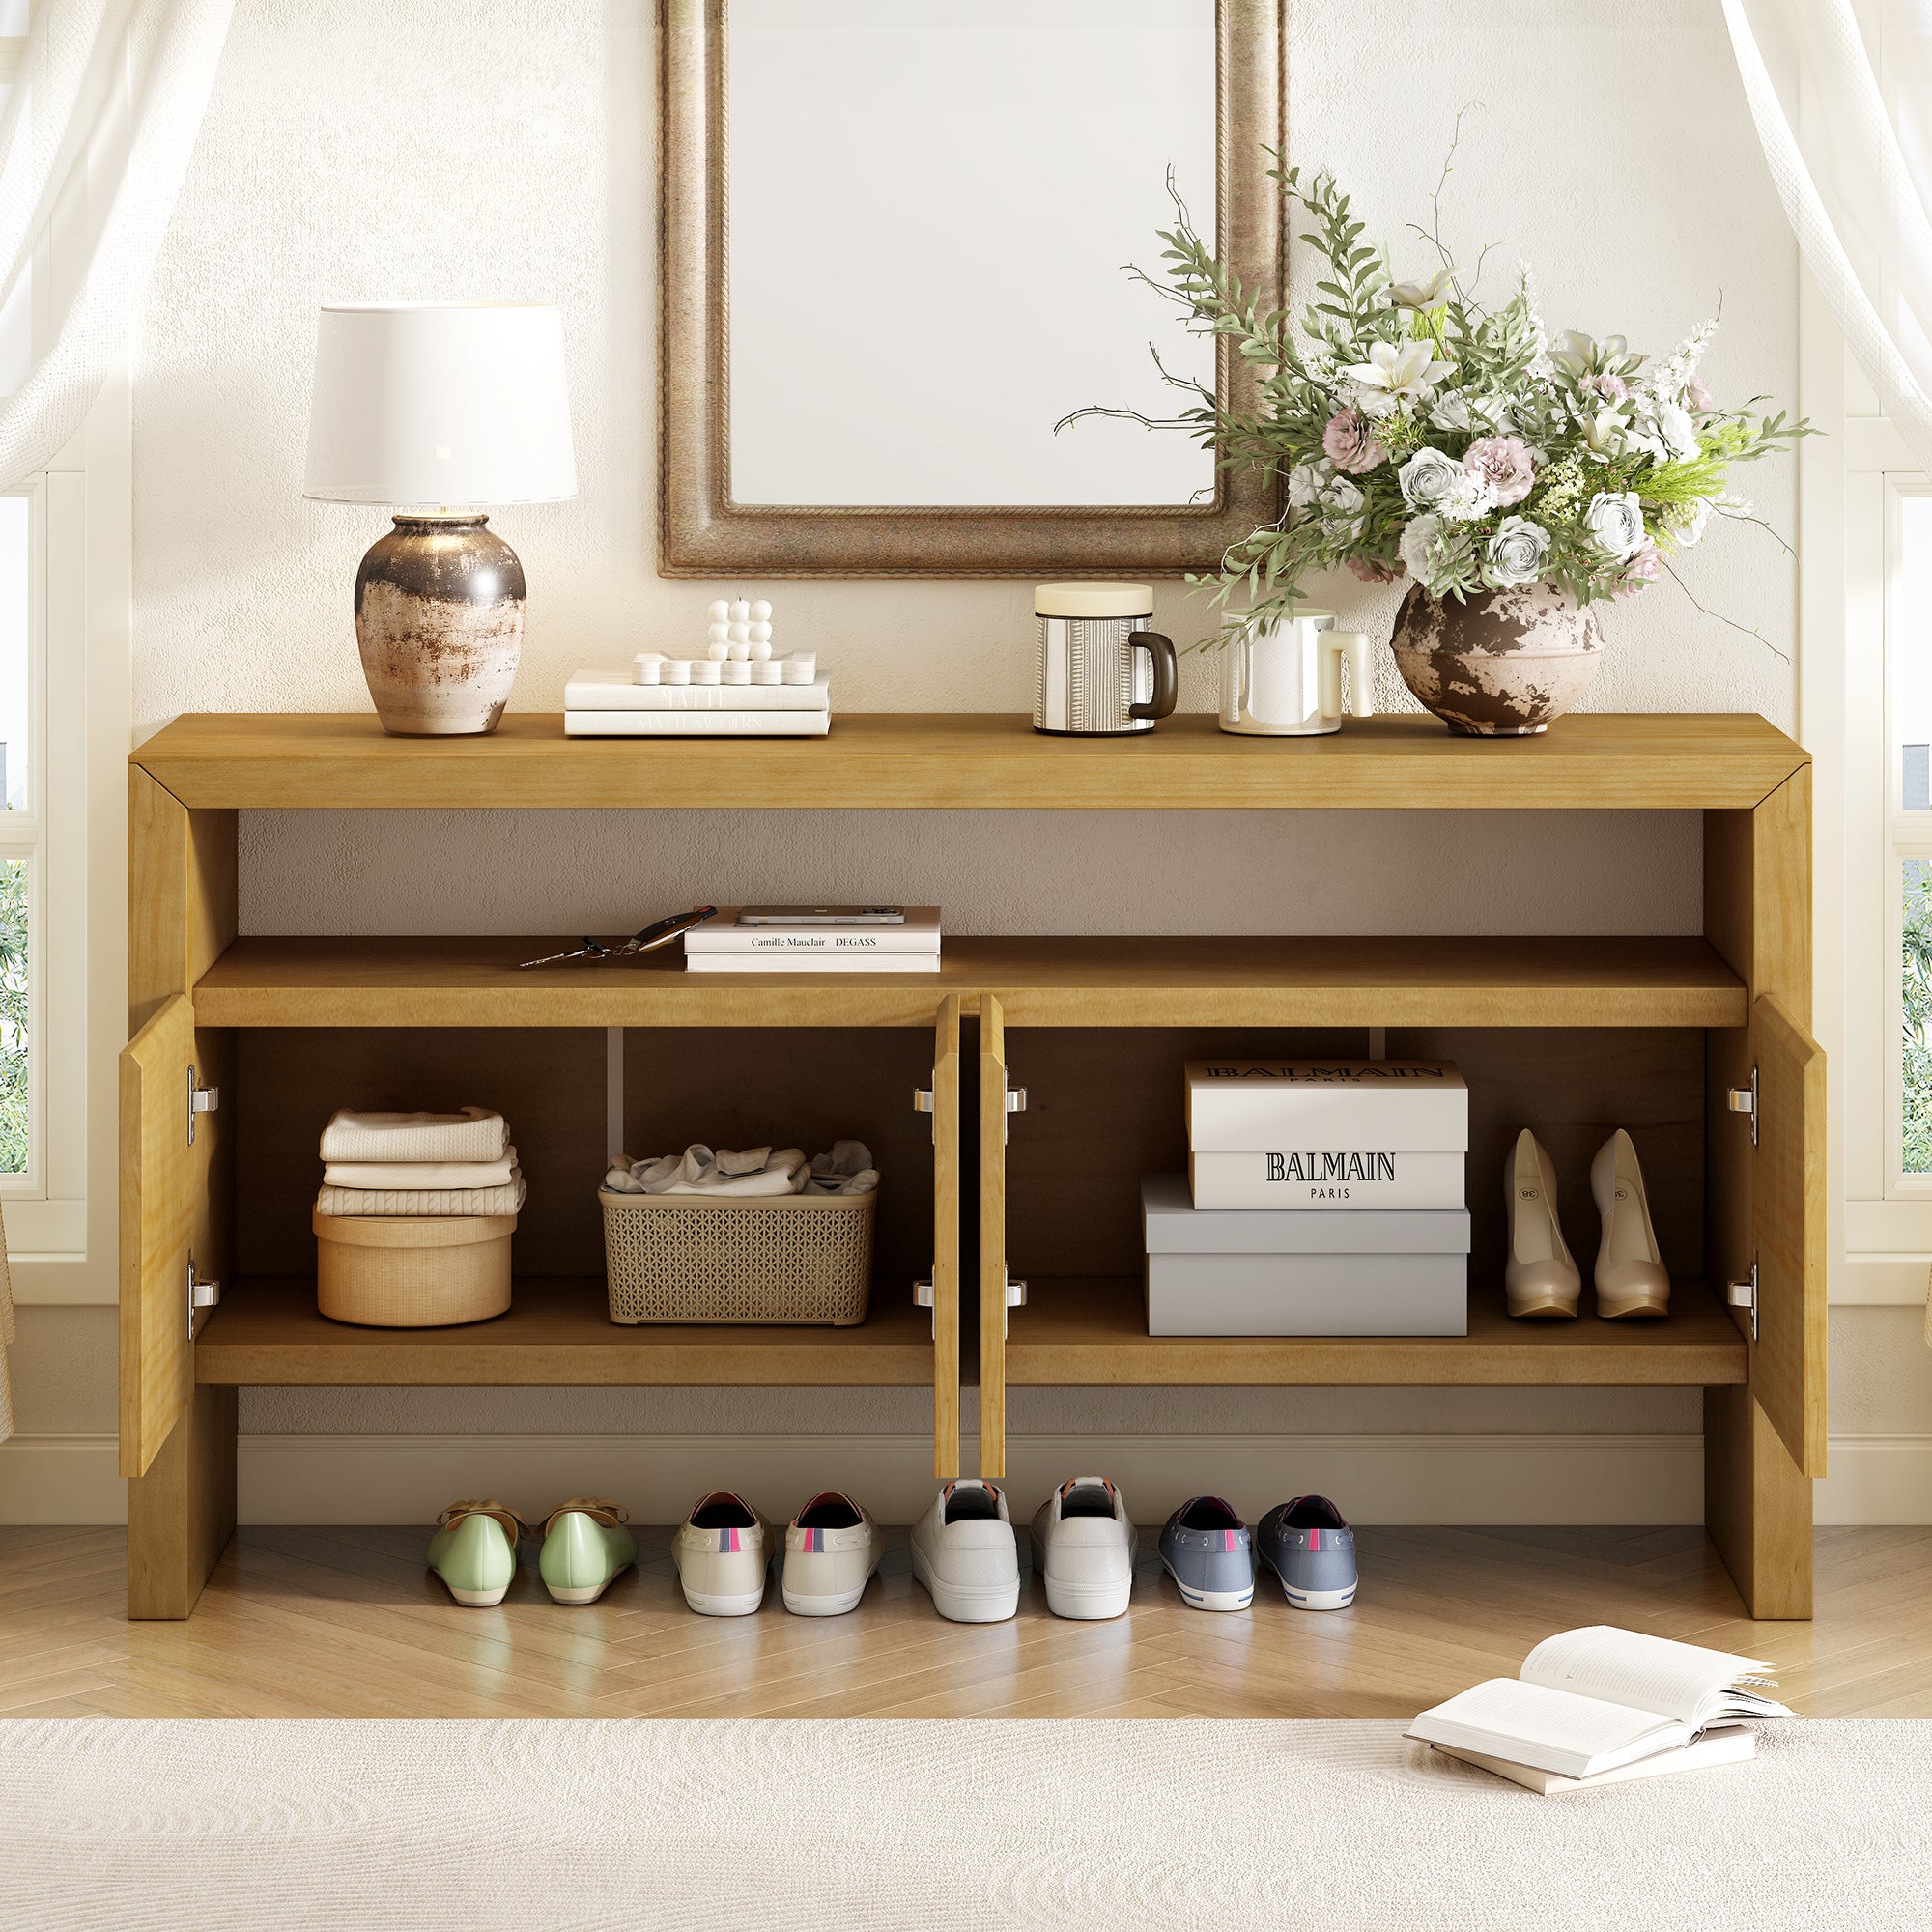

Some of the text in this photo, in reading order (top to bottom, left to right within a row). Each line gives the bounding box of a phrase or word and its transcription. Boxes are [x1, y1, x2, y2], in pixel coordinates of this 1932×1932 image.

[751, 937, 877, 947] Camille Mauclair DEGASS
[1206, 1067, 1445, 1077] BALMAIN
[1265, 1152, 1397, 1181] BALMAIN
[1310, 1188, 1350, 1199] PARIS
